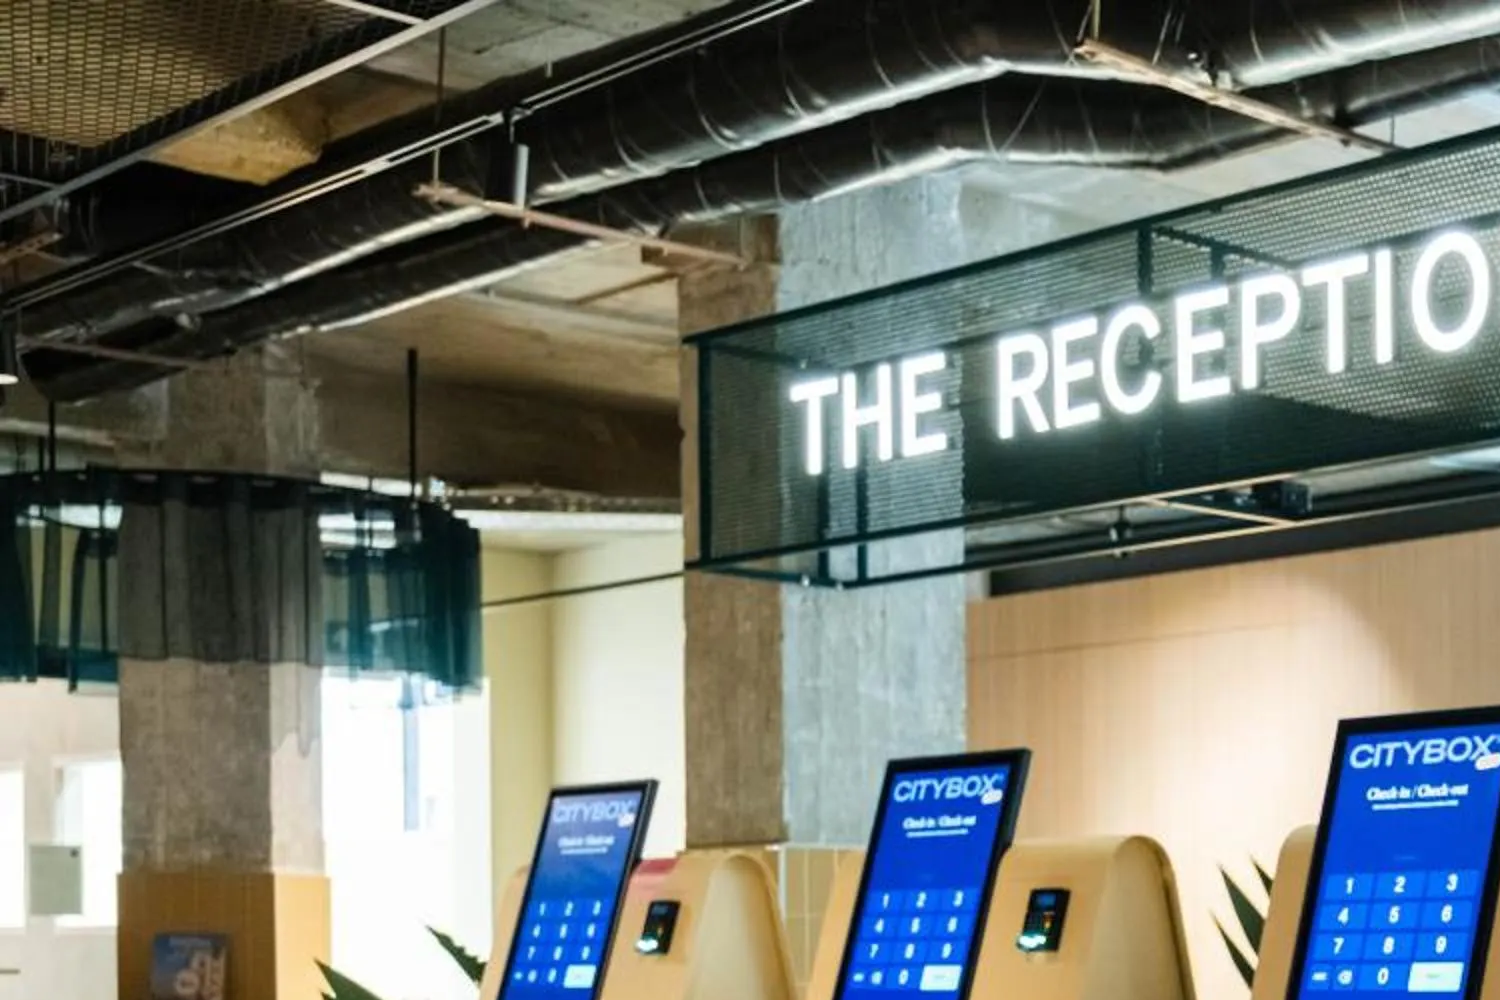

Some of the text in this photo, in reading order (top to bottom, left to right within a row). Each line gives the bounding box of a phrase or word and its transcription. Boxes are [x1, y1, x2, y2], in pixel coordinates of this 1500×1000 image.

[788, 351, 948, 476] THE
[1350, 734, 1498, 769] CITYBOX
[893, 774, 998, 803] CITYBOX
[1346, 873, 1459, 894] 1 2 3
[1337, 904, 1453, 924] 4 5 6
[1333, 936, 1345, 954] 7
[1435, 935, 1447, 954] 9
[1377, 967, 1390, 985] 0
